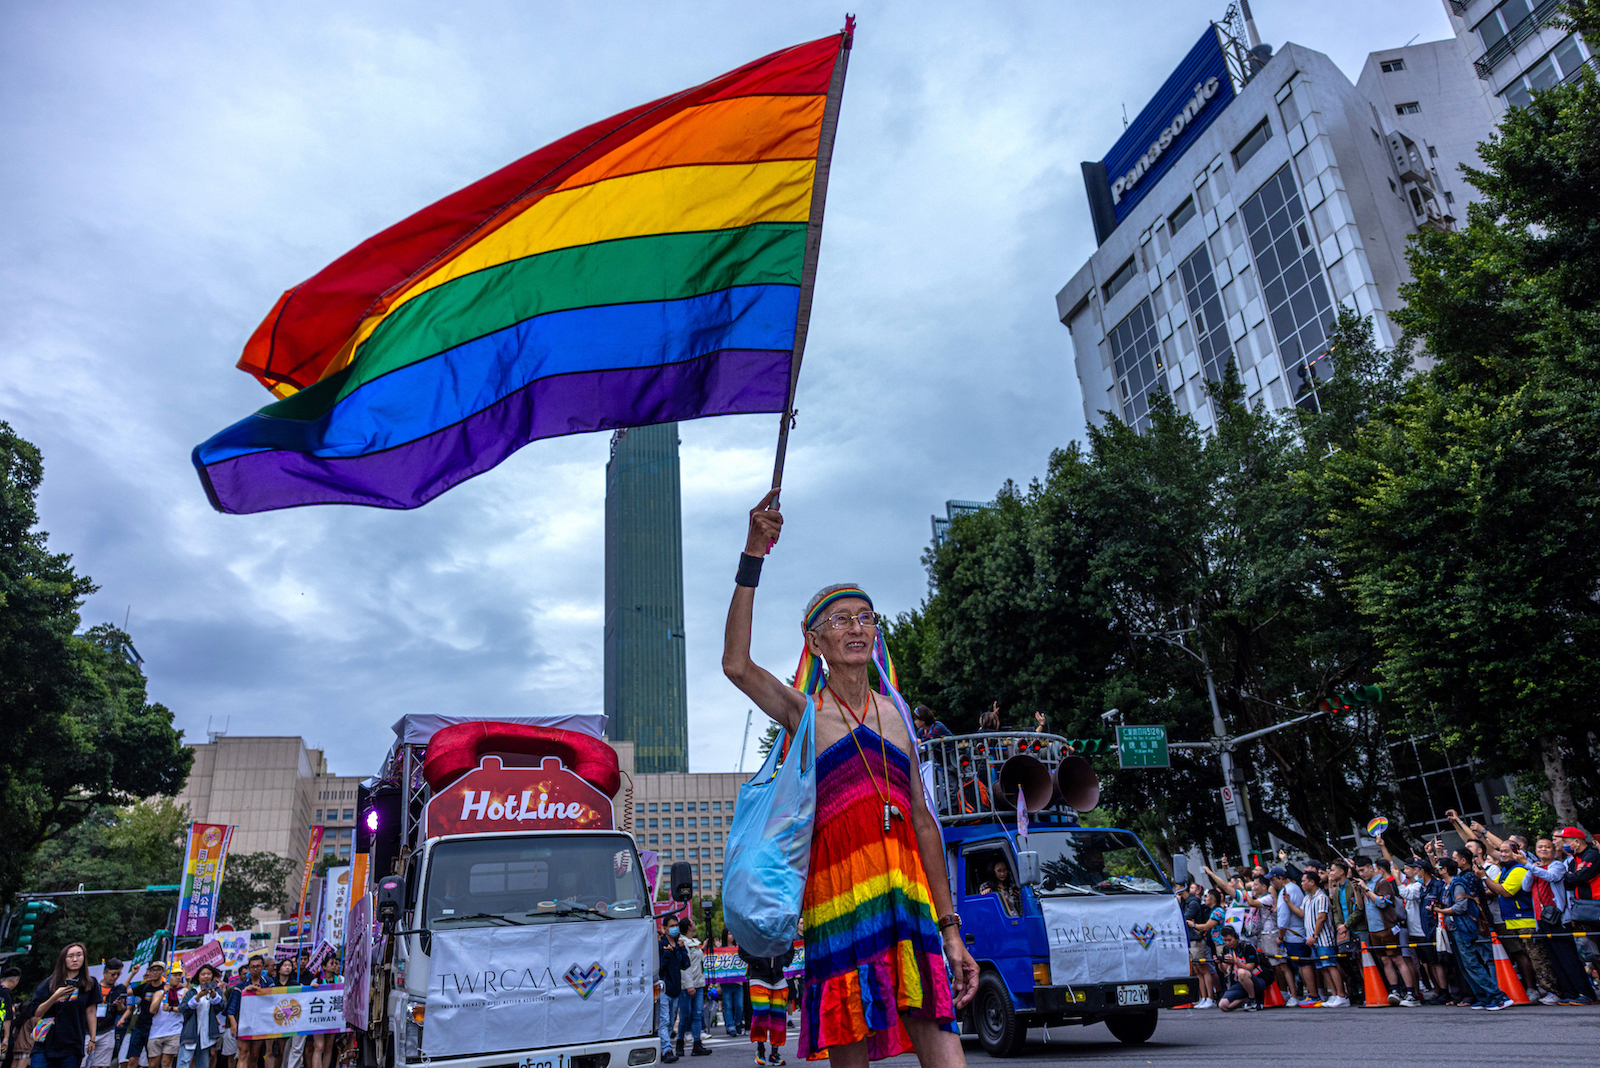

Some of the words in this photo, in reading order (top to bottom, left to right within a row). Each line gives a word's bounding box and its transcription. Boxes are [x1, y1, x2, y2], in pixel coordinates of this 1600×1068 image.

[1111, 76, 1219, 206] Panasonic
[437, 967, 558, 997] TWRCAA
[309, 995, 344, 1014] 台灣
[308, 1016, 337, 1024] TAIWAN
